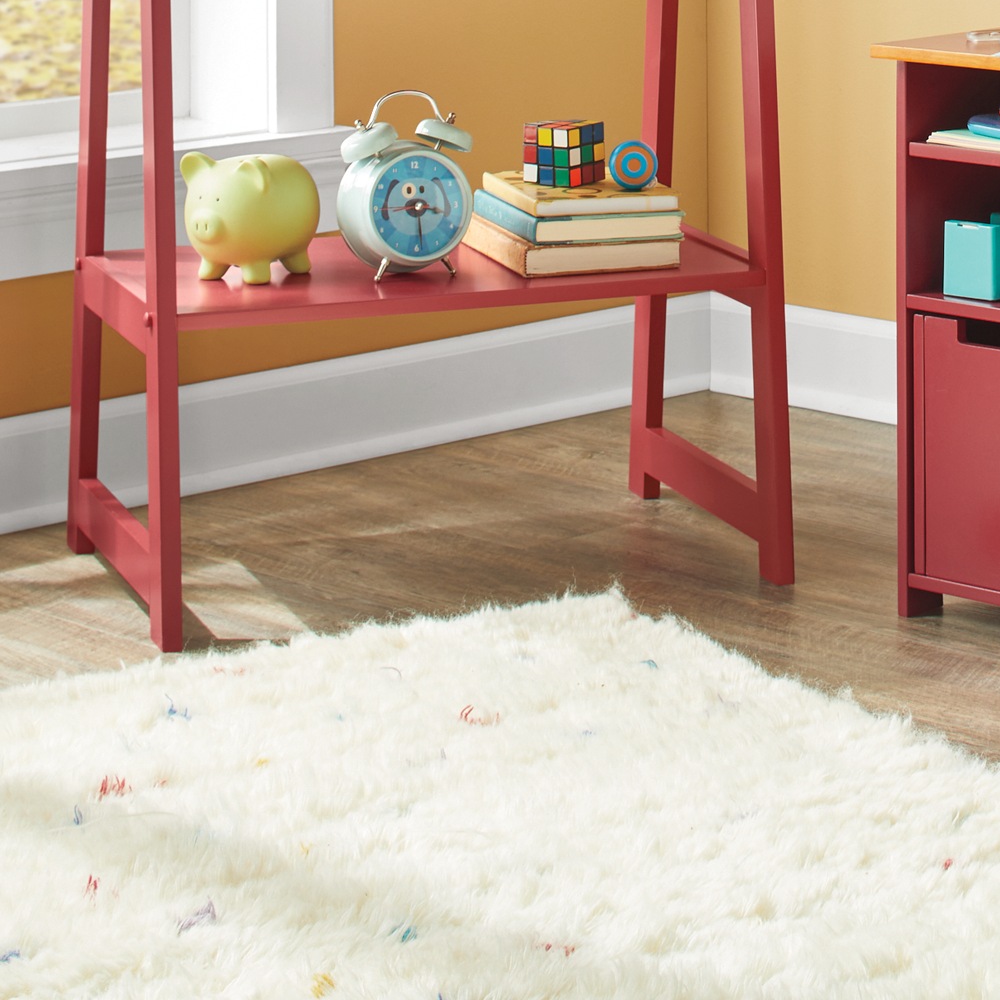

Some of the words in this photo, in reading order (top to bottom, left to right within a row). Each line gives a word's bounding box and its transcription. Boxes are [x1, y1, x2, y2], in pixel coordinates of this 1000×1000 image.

[410, 161, 419, 169] 12
[373, 205, 378, 213] 9
[414, 244, 419, 252] 6
